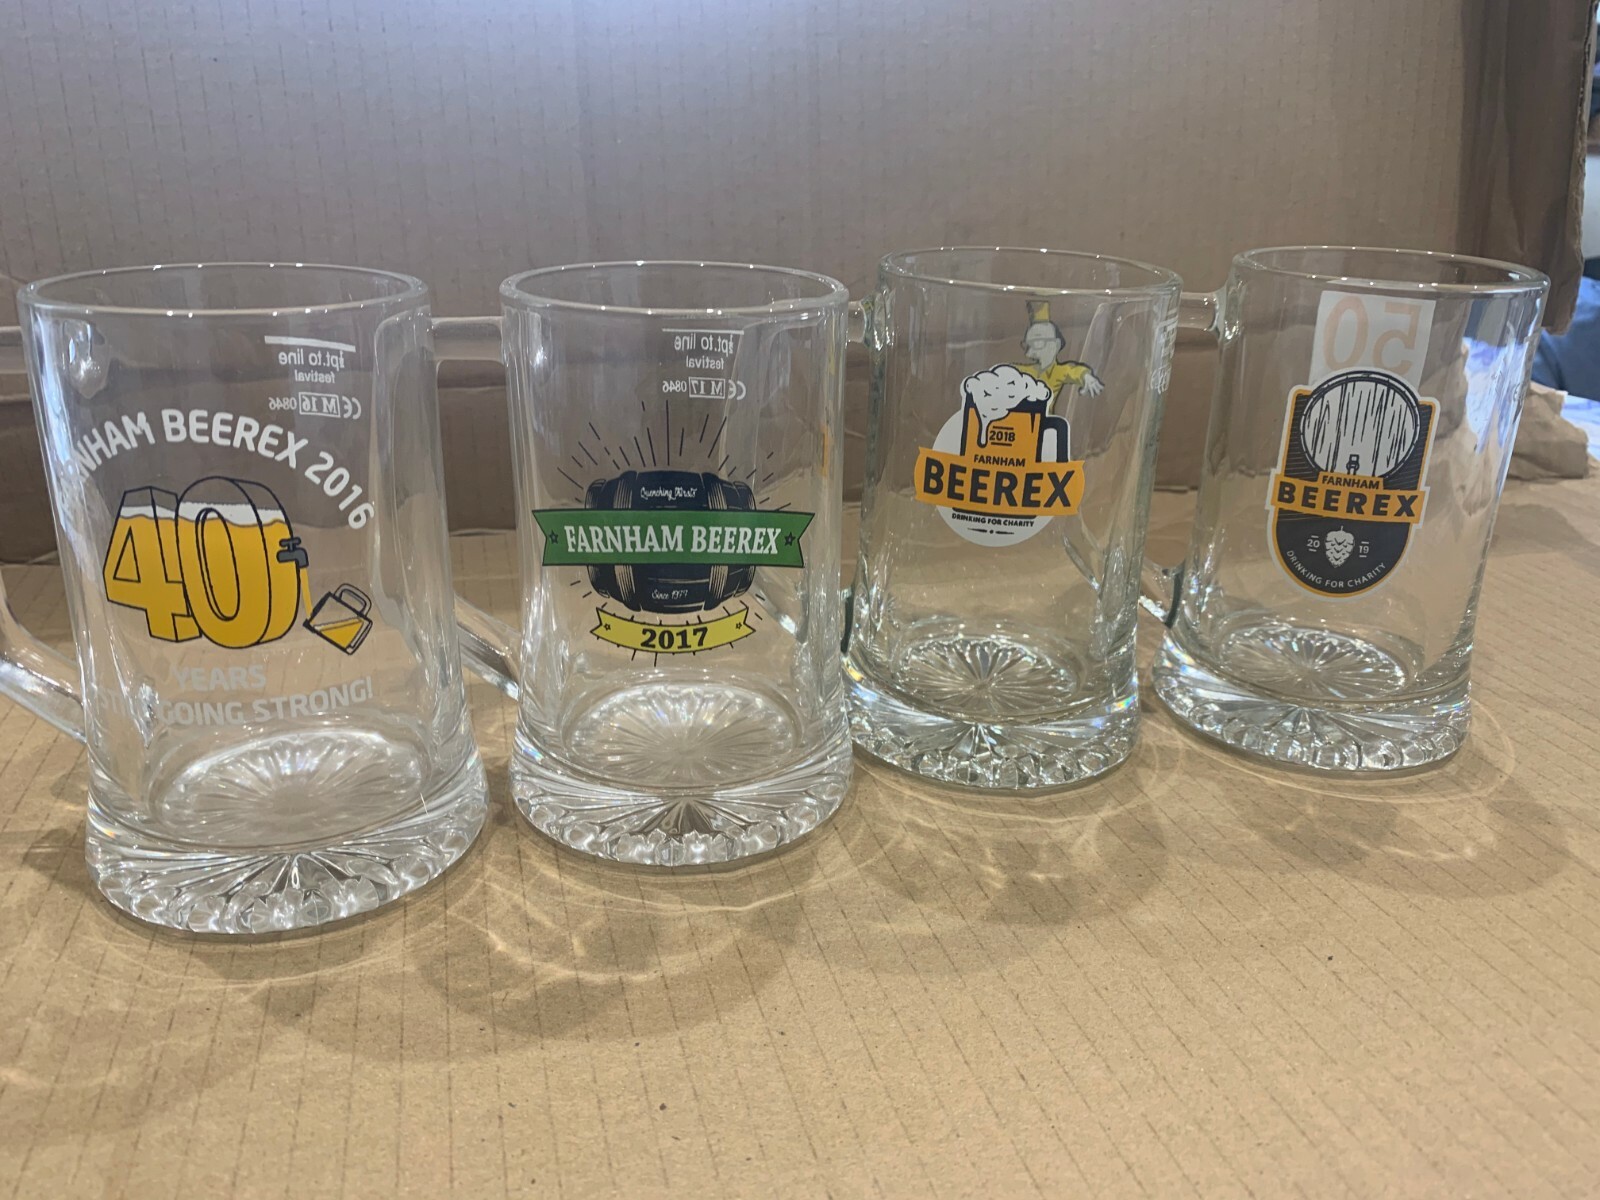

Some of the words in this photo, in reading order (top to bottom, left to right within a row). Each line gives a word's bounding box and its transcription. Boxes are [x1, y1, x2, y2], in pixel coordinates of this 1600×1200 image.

[988, 429, 1016, 443] 2018
[161, 409, 308, 469] BEEREX
[305, 451, 374, 528] 2016
[973, 454, 1026, 468] FARNHAM
[923, 456, 1075, 508] BEEREX
[1321, 475, 1381, 490] FARNHAM
[1277, 481, 1418, 517] BEEREX
[951, 512, 986, 524] DRINKING
[987, 518, 1002, 526] FOR
[1003, 519, 1035, 528] CHARITY
[564, 525, 684, 553] FARNHAM
[690, 526, 782, 555] BEEREX
[1306, 538, 1321, 549] 20
[1358, 545, 1370, 555] 19
[102, 474, 301, 650] 40
[1286, 550, 1322, 585] DRINKING
[1324, 578, 1345, 589] FOR
[1347, 562, 1387, 588] CHARITY
[640, 627, 709, 650] 2017
[171, 664, 268, 692] YEARS
[157, 701, 245, 727] GOING
[251, 676, 373, 722] STRONG!
